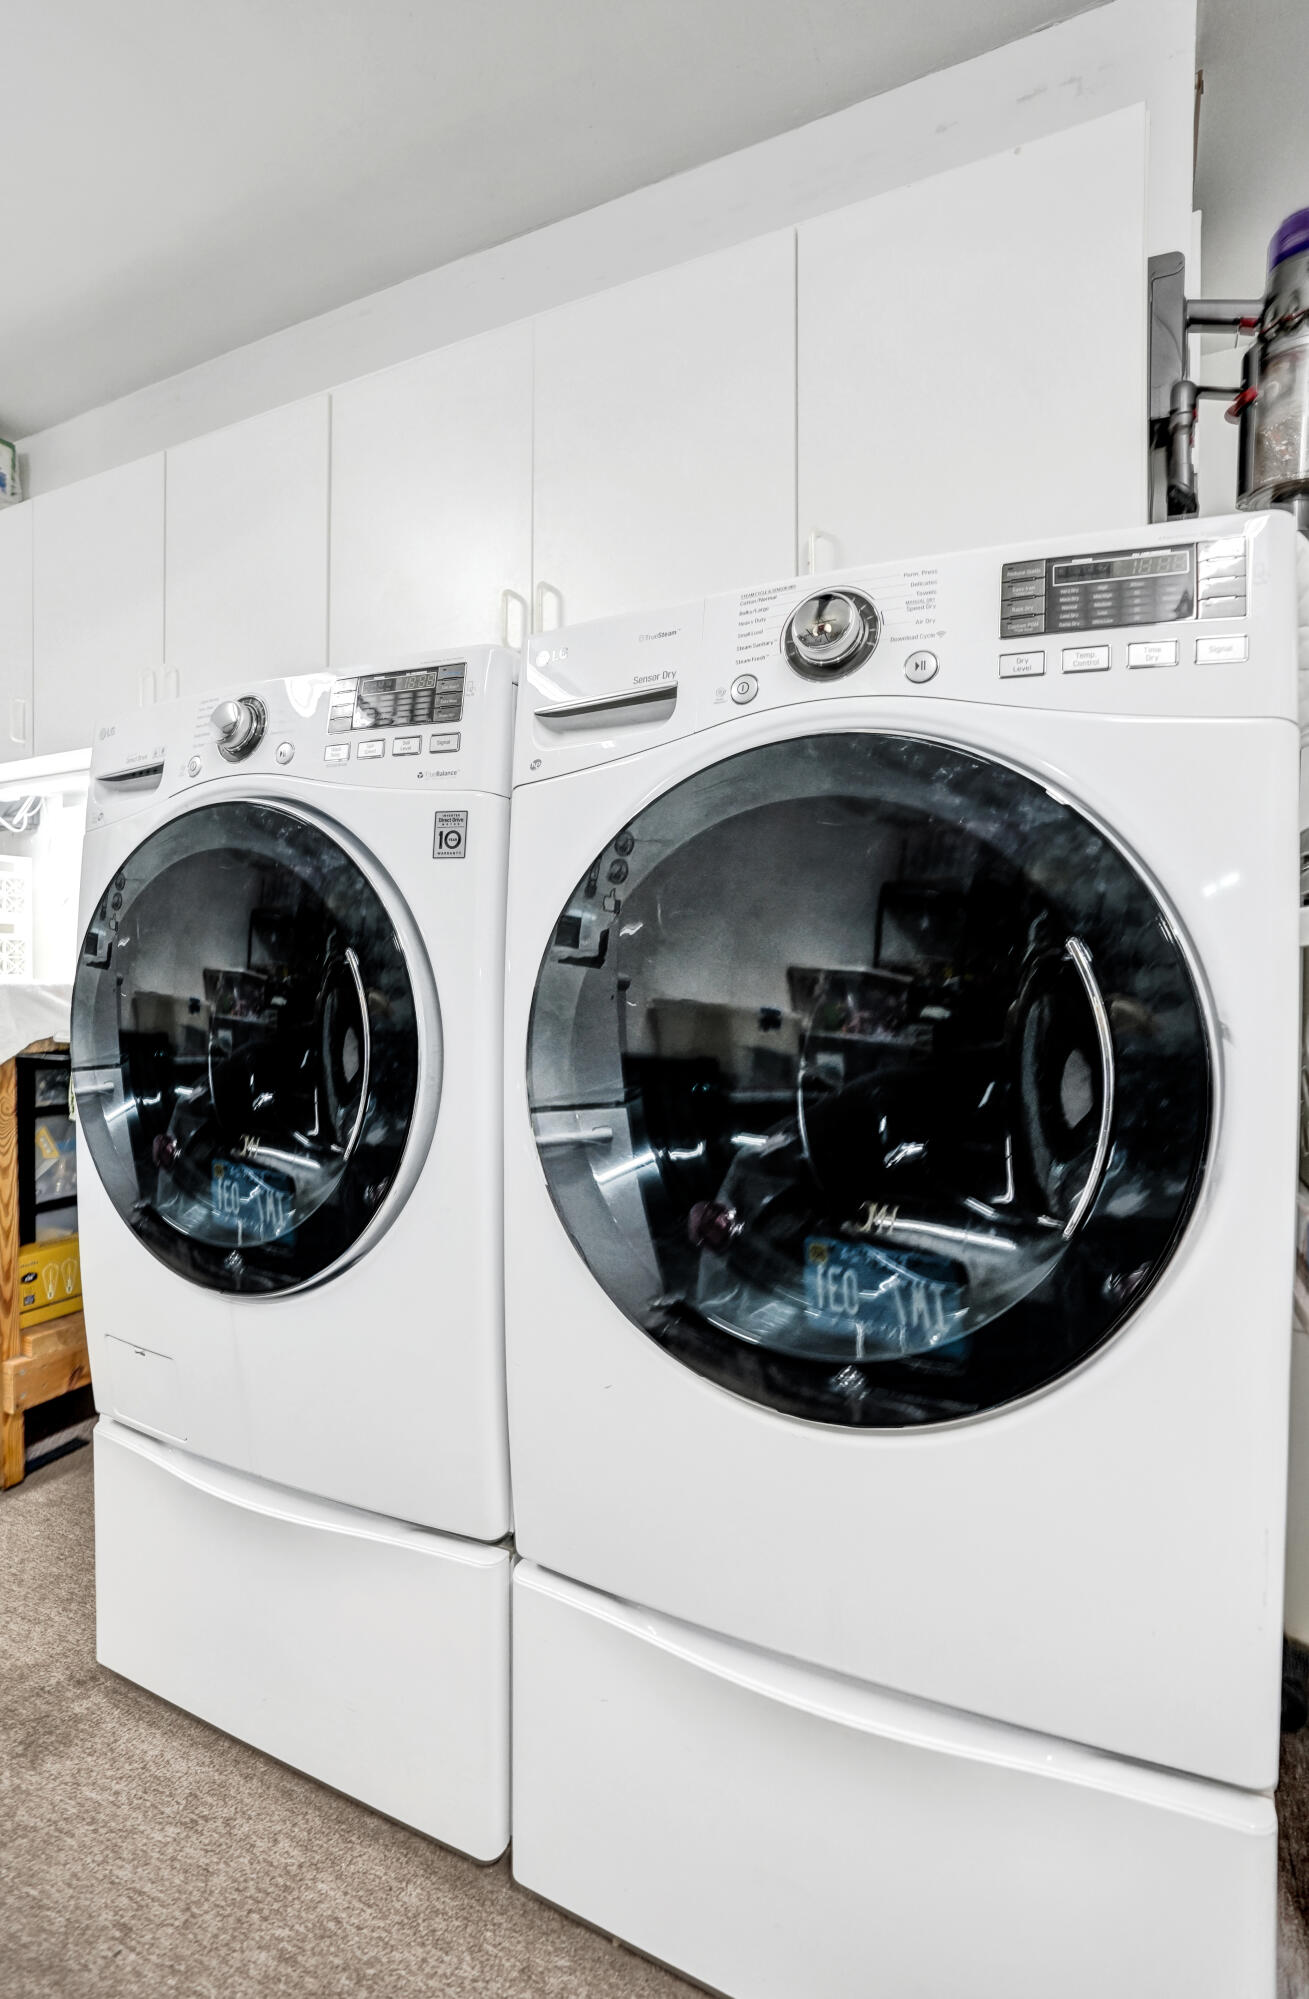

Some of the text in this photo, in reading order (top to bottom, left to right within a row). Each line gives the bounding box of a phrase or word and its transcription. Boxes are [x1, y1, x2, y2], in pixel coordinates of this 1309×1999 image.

[925, 618, 936, 626] Dry
[1143, 646, 1162, 654] Time
[1016, 656, 1029, 666] Dry
[1072, 658, 1100, 667] Control
[1145, 654, 1160, 664] Dry
[1012, 664, 1032, 673] Level
[633, 669, 677, 686] Sensor Dry
[438, 830, 462, 850] 10
